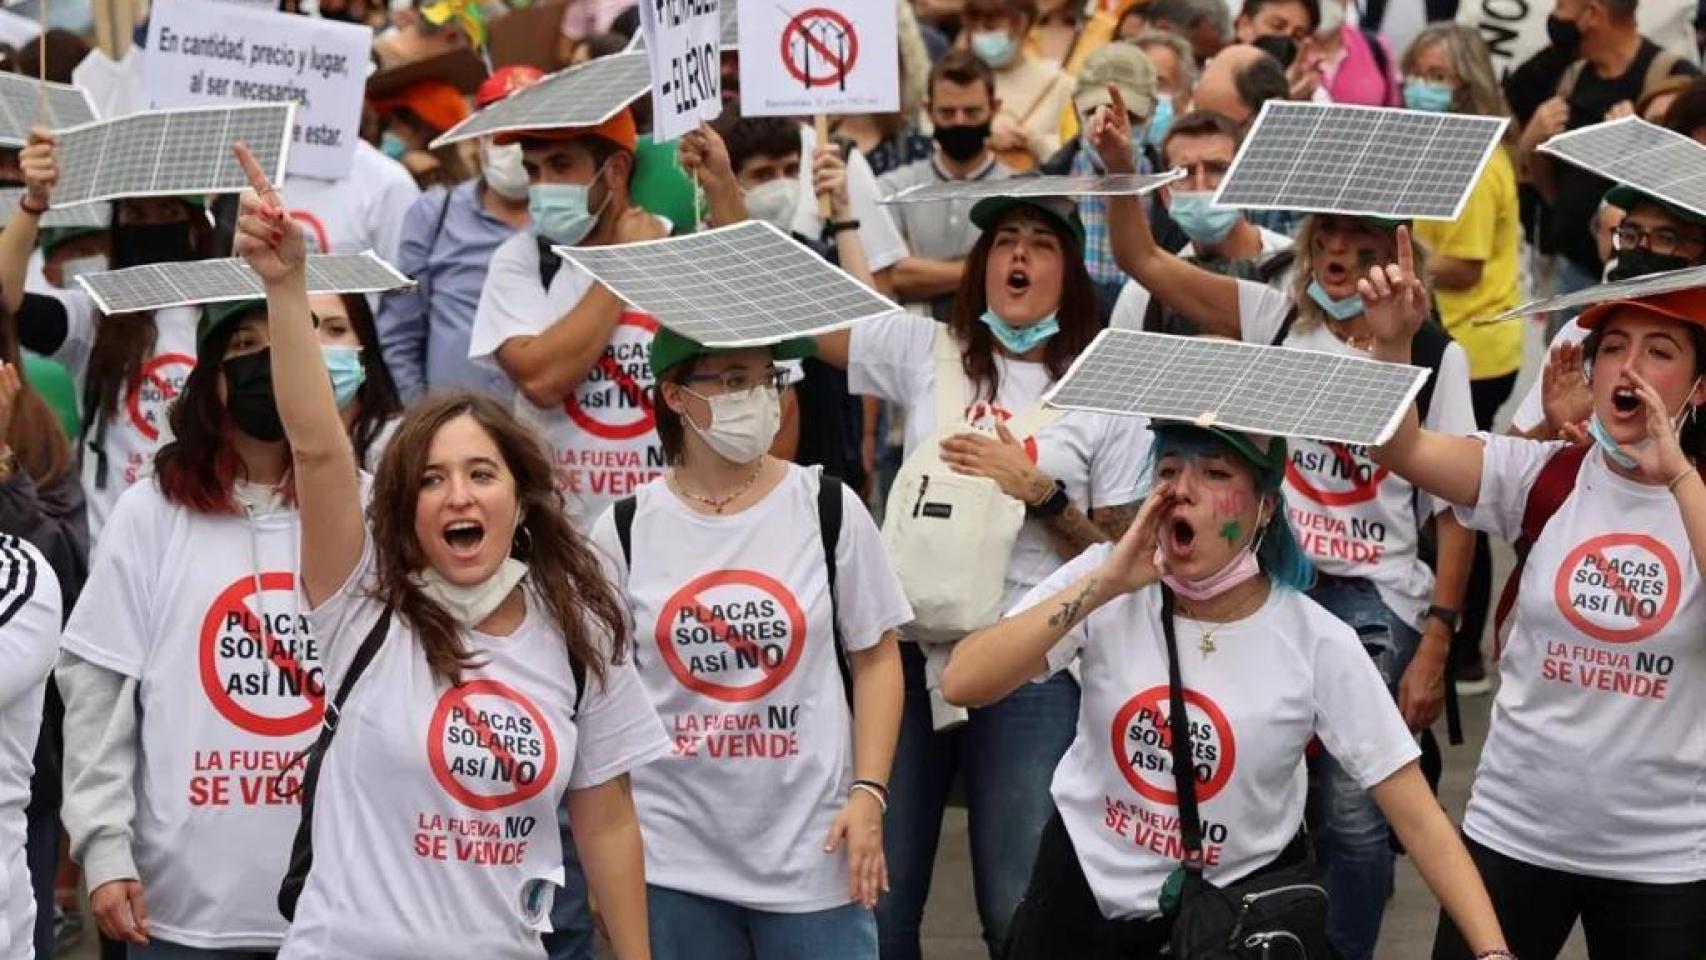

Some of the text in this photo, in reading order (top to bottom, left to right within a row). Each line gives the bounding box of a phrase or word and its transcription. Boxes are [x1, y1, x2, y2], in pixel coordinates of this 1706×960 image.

[159, 26, 349, 79] En cantidad, precio y lugar,
[190, 71, 204, 94] al
[207, 77, 230, 97] ser
[304, 124, 343, 147] estar.
[581, 451, 641, 466] FUEVA
[647, 445, 665, 467] N
[560, 470, 584, 493] SE
[1331, 455, 1372, 487] NO
[1288, 508, 1386, 542] FUEVA NO
[1301, 533, 1385, 564] VENDE
[1584, 554, 1660, 578] PLACAS
[1575, 569, 1664, 596] SOLARES
[679, 599, 776, 624] PLACAS
[1614, 595, 1658, 620] NO
[226, 610, 310, 635] PLACA
[676, 620, 787, 646] SOLARES
[220, 636, 320, 661] SOLARE
[735, 643, 785, 671] NO
[1547, 640, 1675, 676] LA FUEVA NO
[278, 667, 326, 698] NO
[1542, 659, 1669, 699] SE VENDE
[452, 706, 533, 735] PLACAS
[674, 713, 699, 732] LA
[703, 712, 762, 731] FUEVA
[447, 726, 542, 757] SOLARES
[673, 731, 800, 759] SE VENDE
[194, 751, 305, 771] LA FUEVA
[491, 757, 538, 787] NO
[188, 775, 304, 807] SE VEN
[418, 812, 536, 840] LA FUEVA NO
[1105, 807, 1131, 837] SE
[414, 834, 528, 866] SE VENDE
